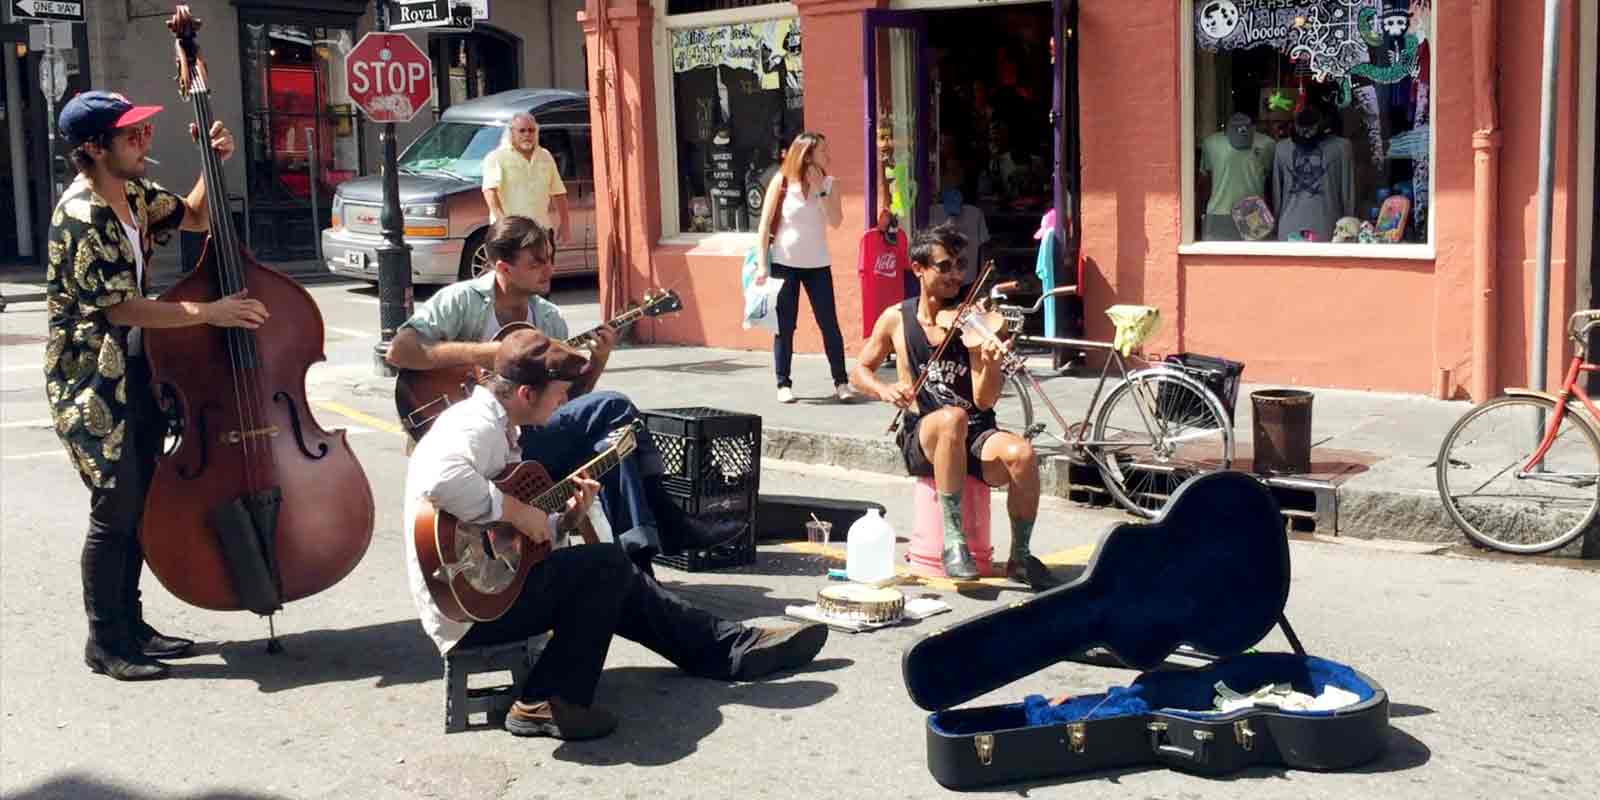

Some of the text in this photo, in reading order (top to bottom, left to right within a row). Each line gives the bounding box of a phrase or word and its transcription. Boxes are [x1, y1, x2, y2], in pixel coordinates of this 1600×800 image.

[33, 1, 55, 12] ONE
[400, 3, 437, 22] Royal
[1240, 11, 1287, 43] Voodoo
[352, 60, 425, 95] STOP
